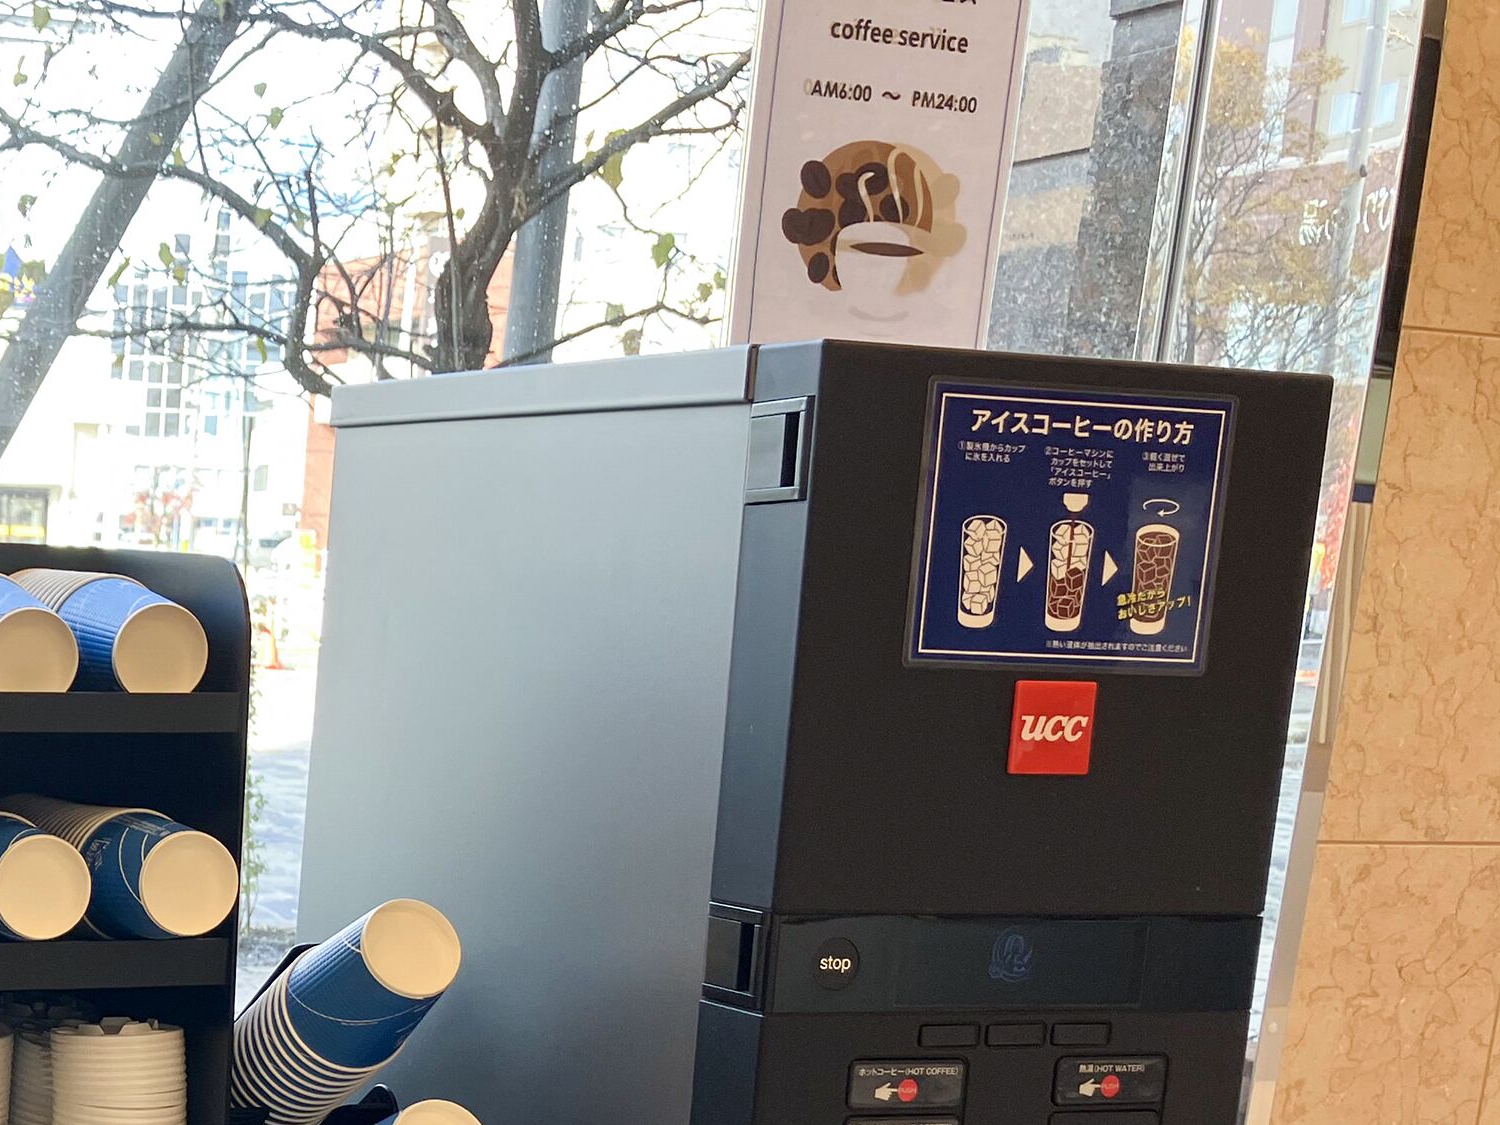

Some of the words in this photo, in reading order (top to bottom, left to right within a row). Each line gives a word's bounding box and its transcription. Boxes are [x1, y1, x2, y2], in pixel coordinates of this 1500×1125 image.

[830, 19, 893, 45] coffee
[898, 28, 969, 53] service
[810, 79, 872, 102] AM6:00
[911, 90, 978, 114] PM24:00
[970, 409, 1195, 445] アイスコーヒーの作り方
[965, 452, 1011, 463] に氷を入れる
[1050, 457, 1113, 469] カップをセットして
[1021, 715, 1089, 742] ucc
[819, 955, 851, 974] stop
